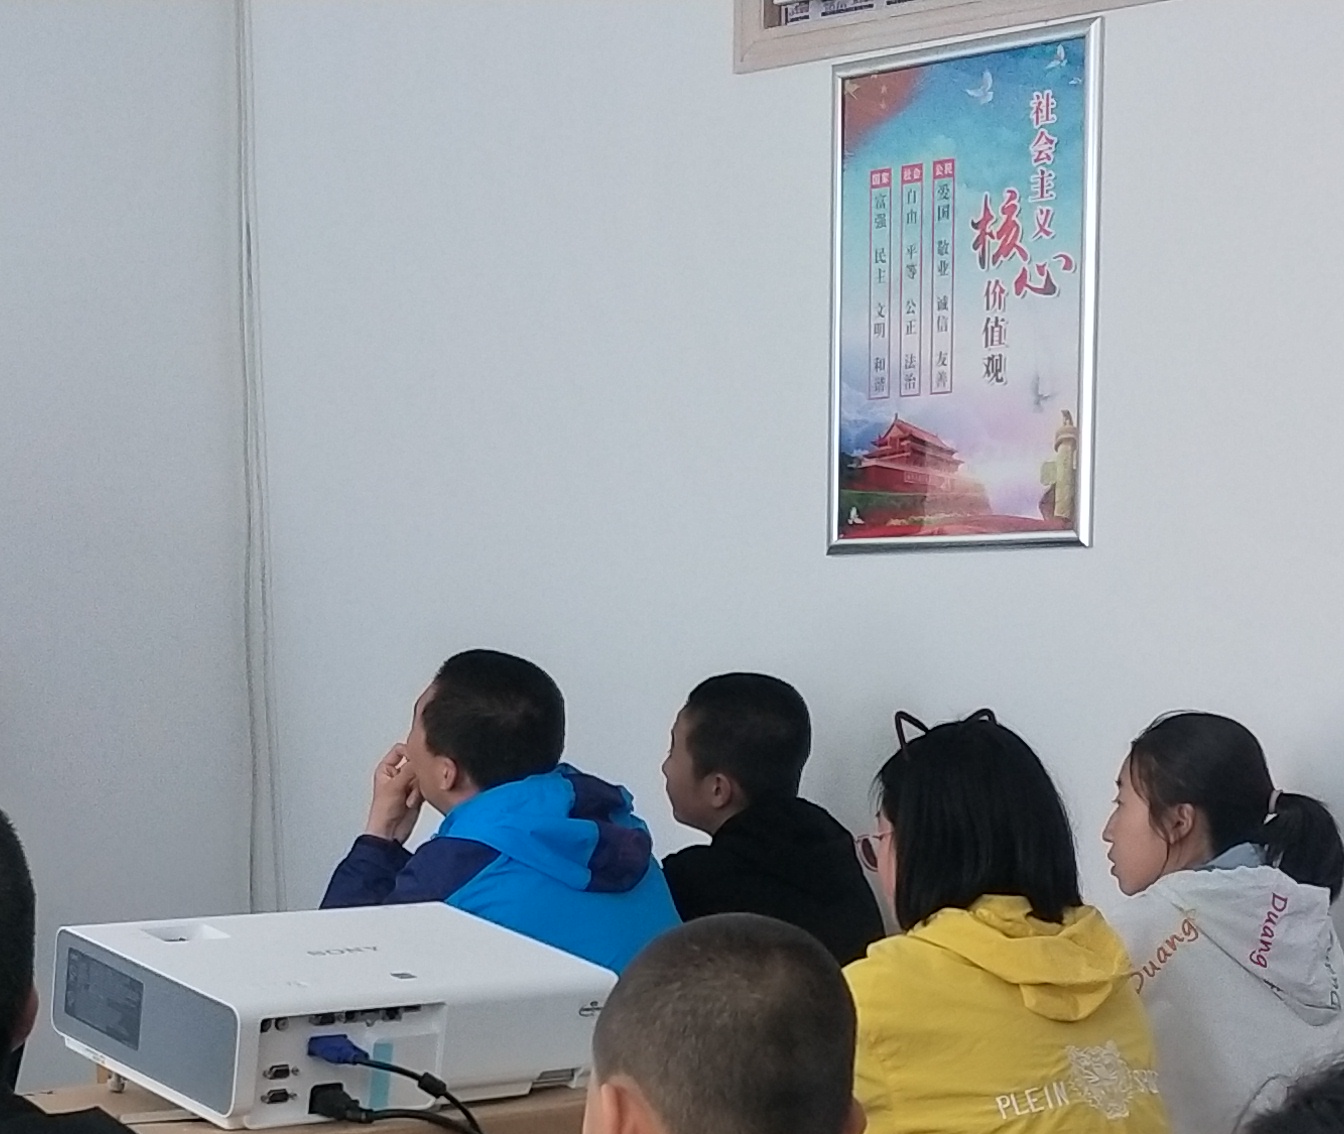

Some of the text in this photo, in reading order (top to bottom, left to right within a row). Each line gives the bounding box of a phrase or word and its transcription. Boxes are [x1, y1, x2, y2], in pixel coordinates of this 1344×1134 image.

[1030, 90, 1056, 239] 社会主义
[874, 193, 887, 393] 富强 民主 文明 和谐
[904, 188, 917, 390] 自由 平等 公正 法治
[936, 183, 950, 388] 爱国 敬业 诚信 友善
[971, 188, 1075, 297] 核心
[983, 279, 1007, 384] 价值观
[1249, 892, 1288, 968] Duang
[995, 1081, 1070, 1120] PLEIN
